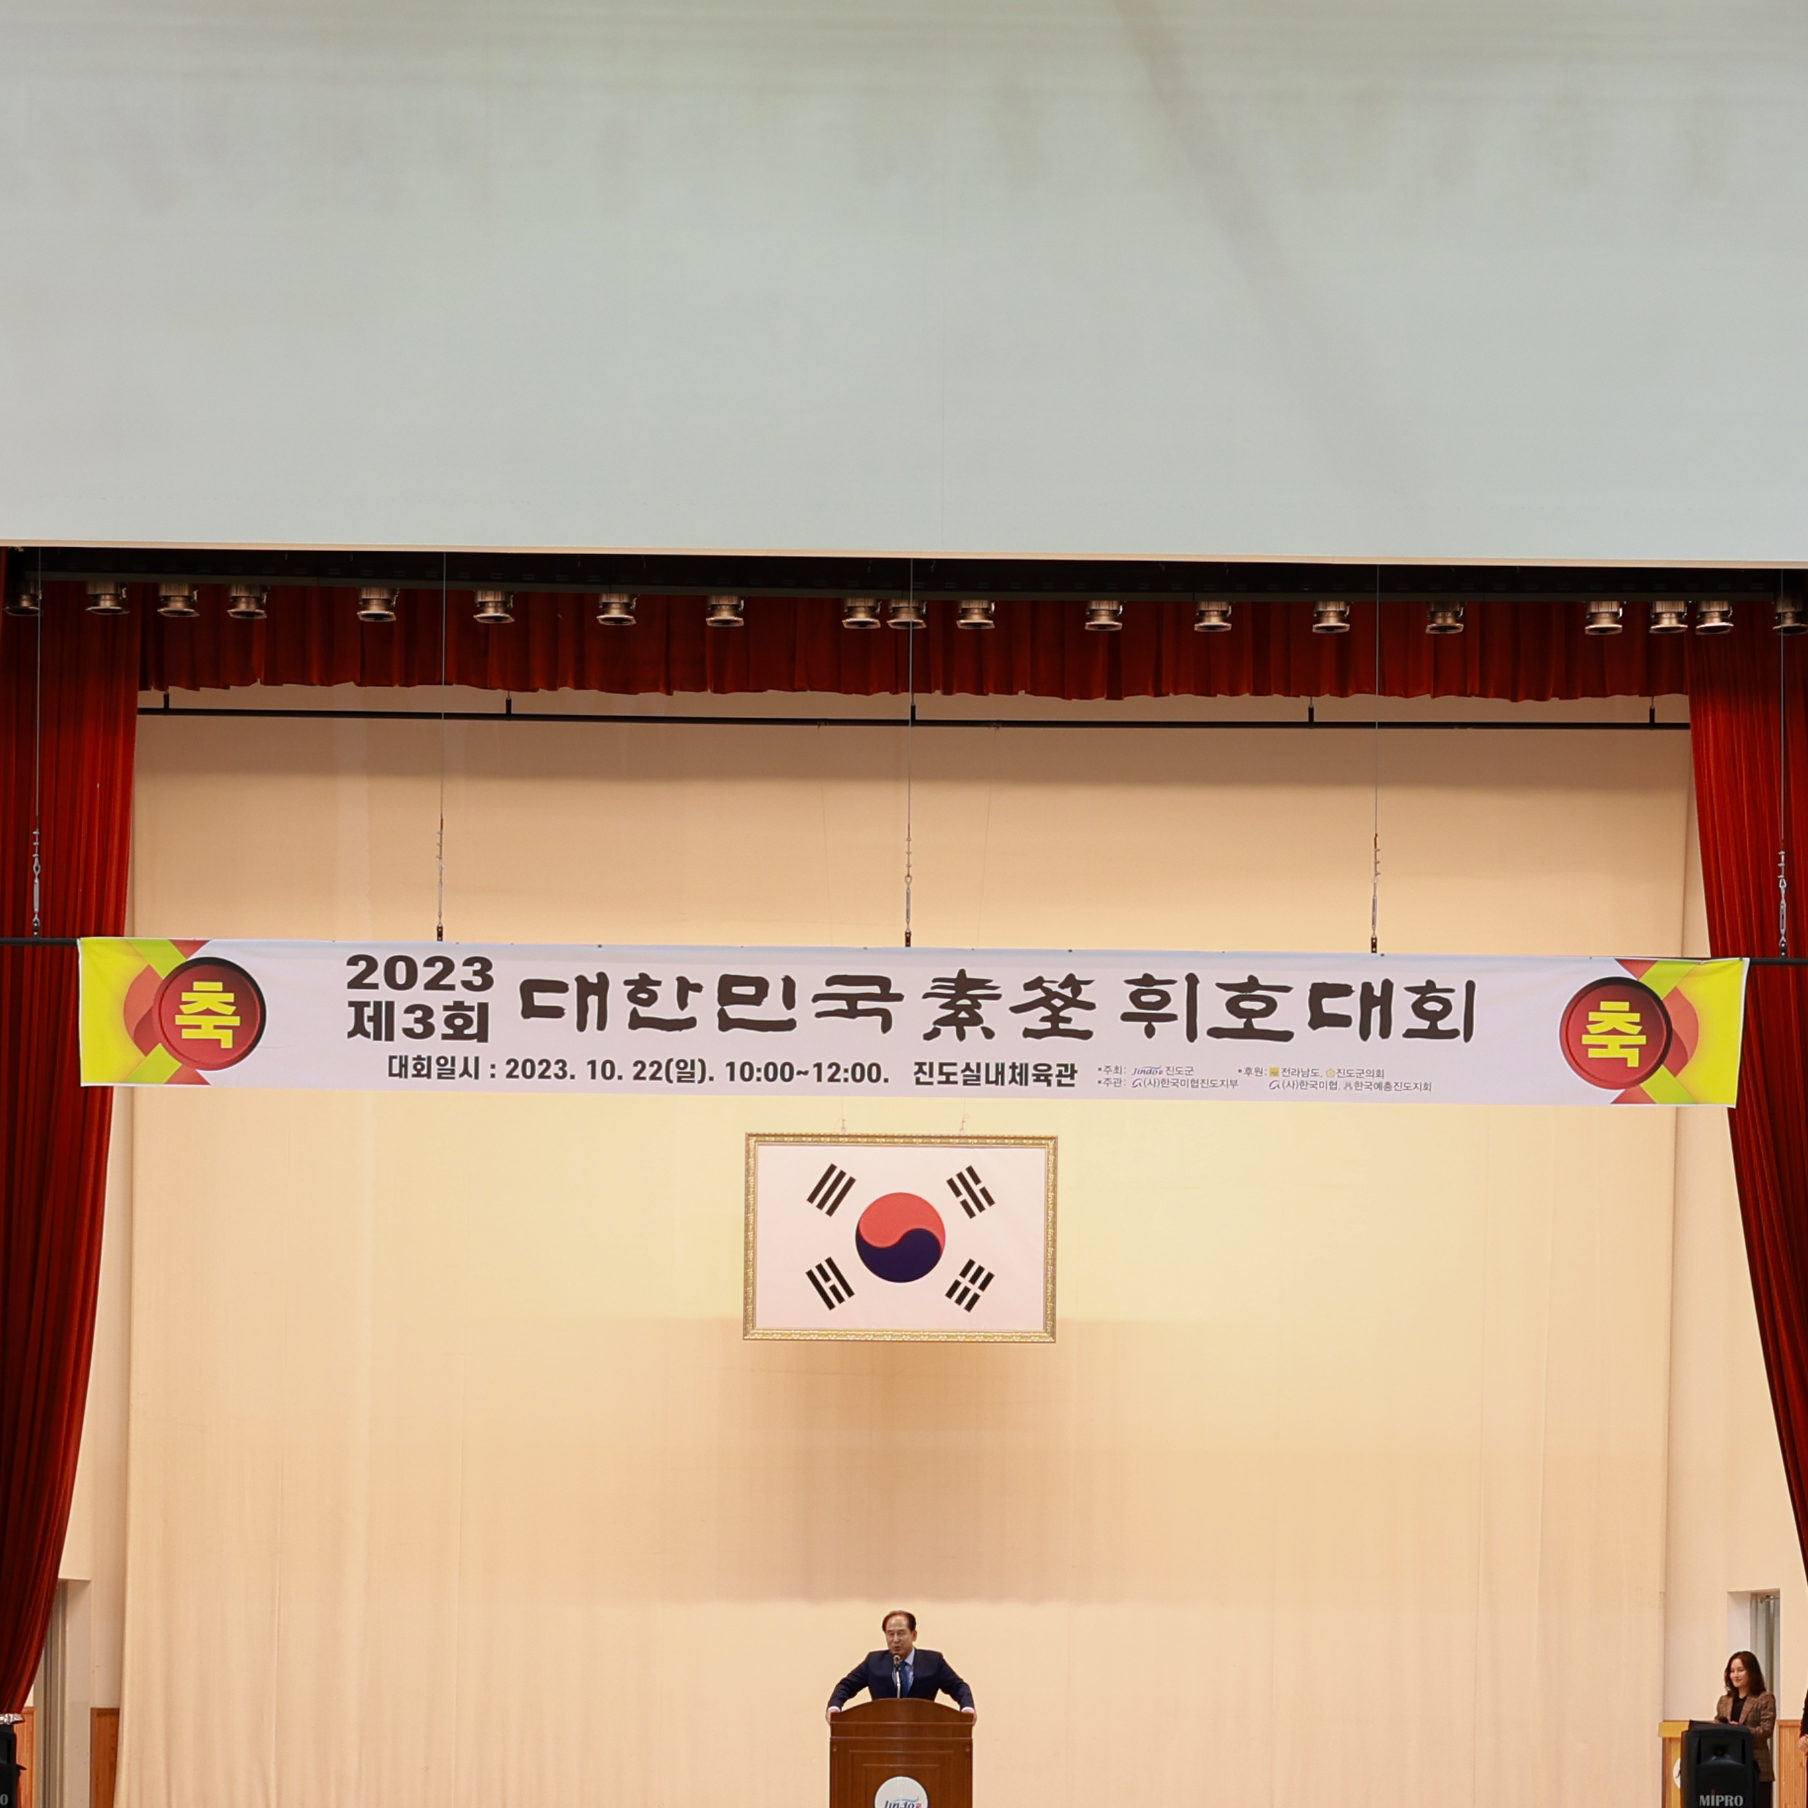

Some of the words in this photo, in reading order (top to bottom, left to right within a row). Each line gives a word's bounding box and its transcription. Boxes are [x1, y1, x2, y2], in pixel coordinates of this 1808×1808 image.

[346, 954, 494, 992] 2023
[175, 981, 241, 1049] 축
[347, 1000, 489, 1043] 제3회
[519, 971, 905, 1035] 대한민국
[1120, 972, 1476, 1043] 휘호대회
[1581, 1001, 1647, 1068] 축
[388, 1054, 480, 1080] 대회일시
[505, 1058, 575, 1080] 2023.
[587, 1059, 623, 1081] 10.
[632, 1058, 714, 1084] 22(일).
[725, 1061, 889, 1084] 10:00~12:00.
[913, 1061, 1078, 1088] 진도실내체육관
[1165, 1066, 1195, 1077] 진도군
[1335, 1068, 1386, 1079] 진도군의회
[1699, 1794, 1744, 1807] MIPRO
